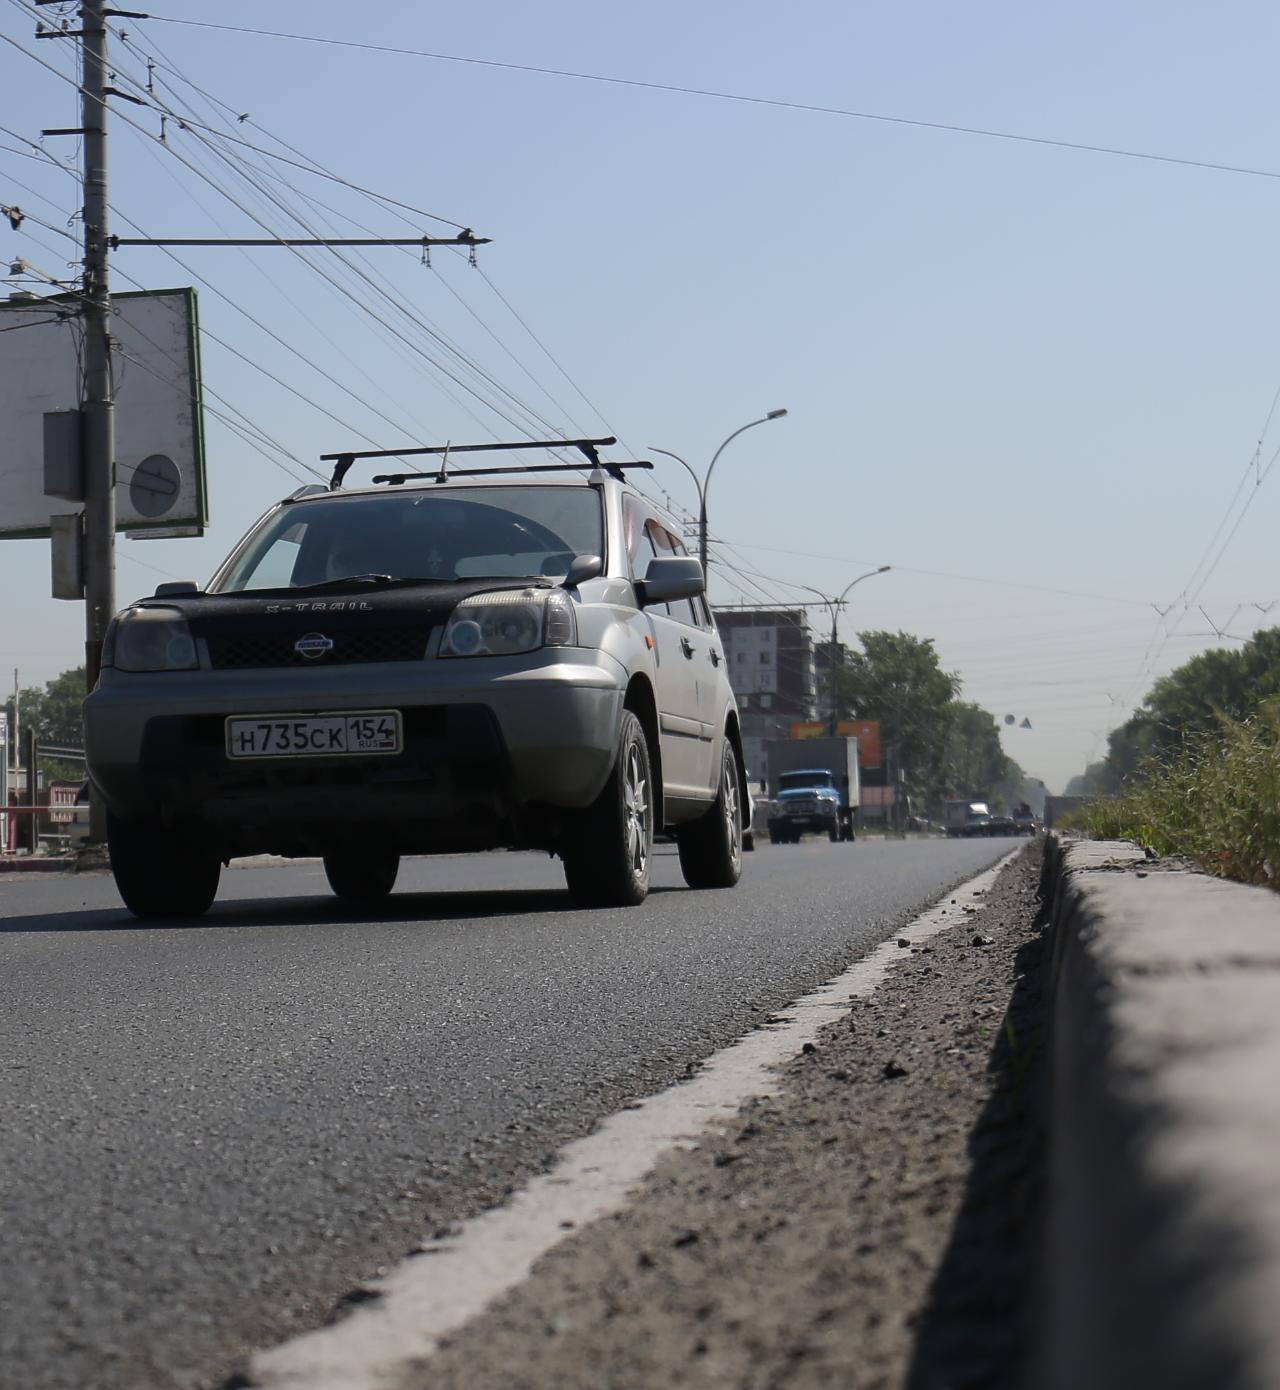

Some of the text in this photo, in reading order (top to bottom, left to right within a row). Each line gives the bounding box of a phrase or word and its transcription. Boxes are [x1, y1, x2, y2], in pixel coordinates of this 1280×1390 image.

[265, 602, 374, 614] X-TRAIL
[350, 719, 392, 740] 154
[358, 740, 378, 749] RUS
